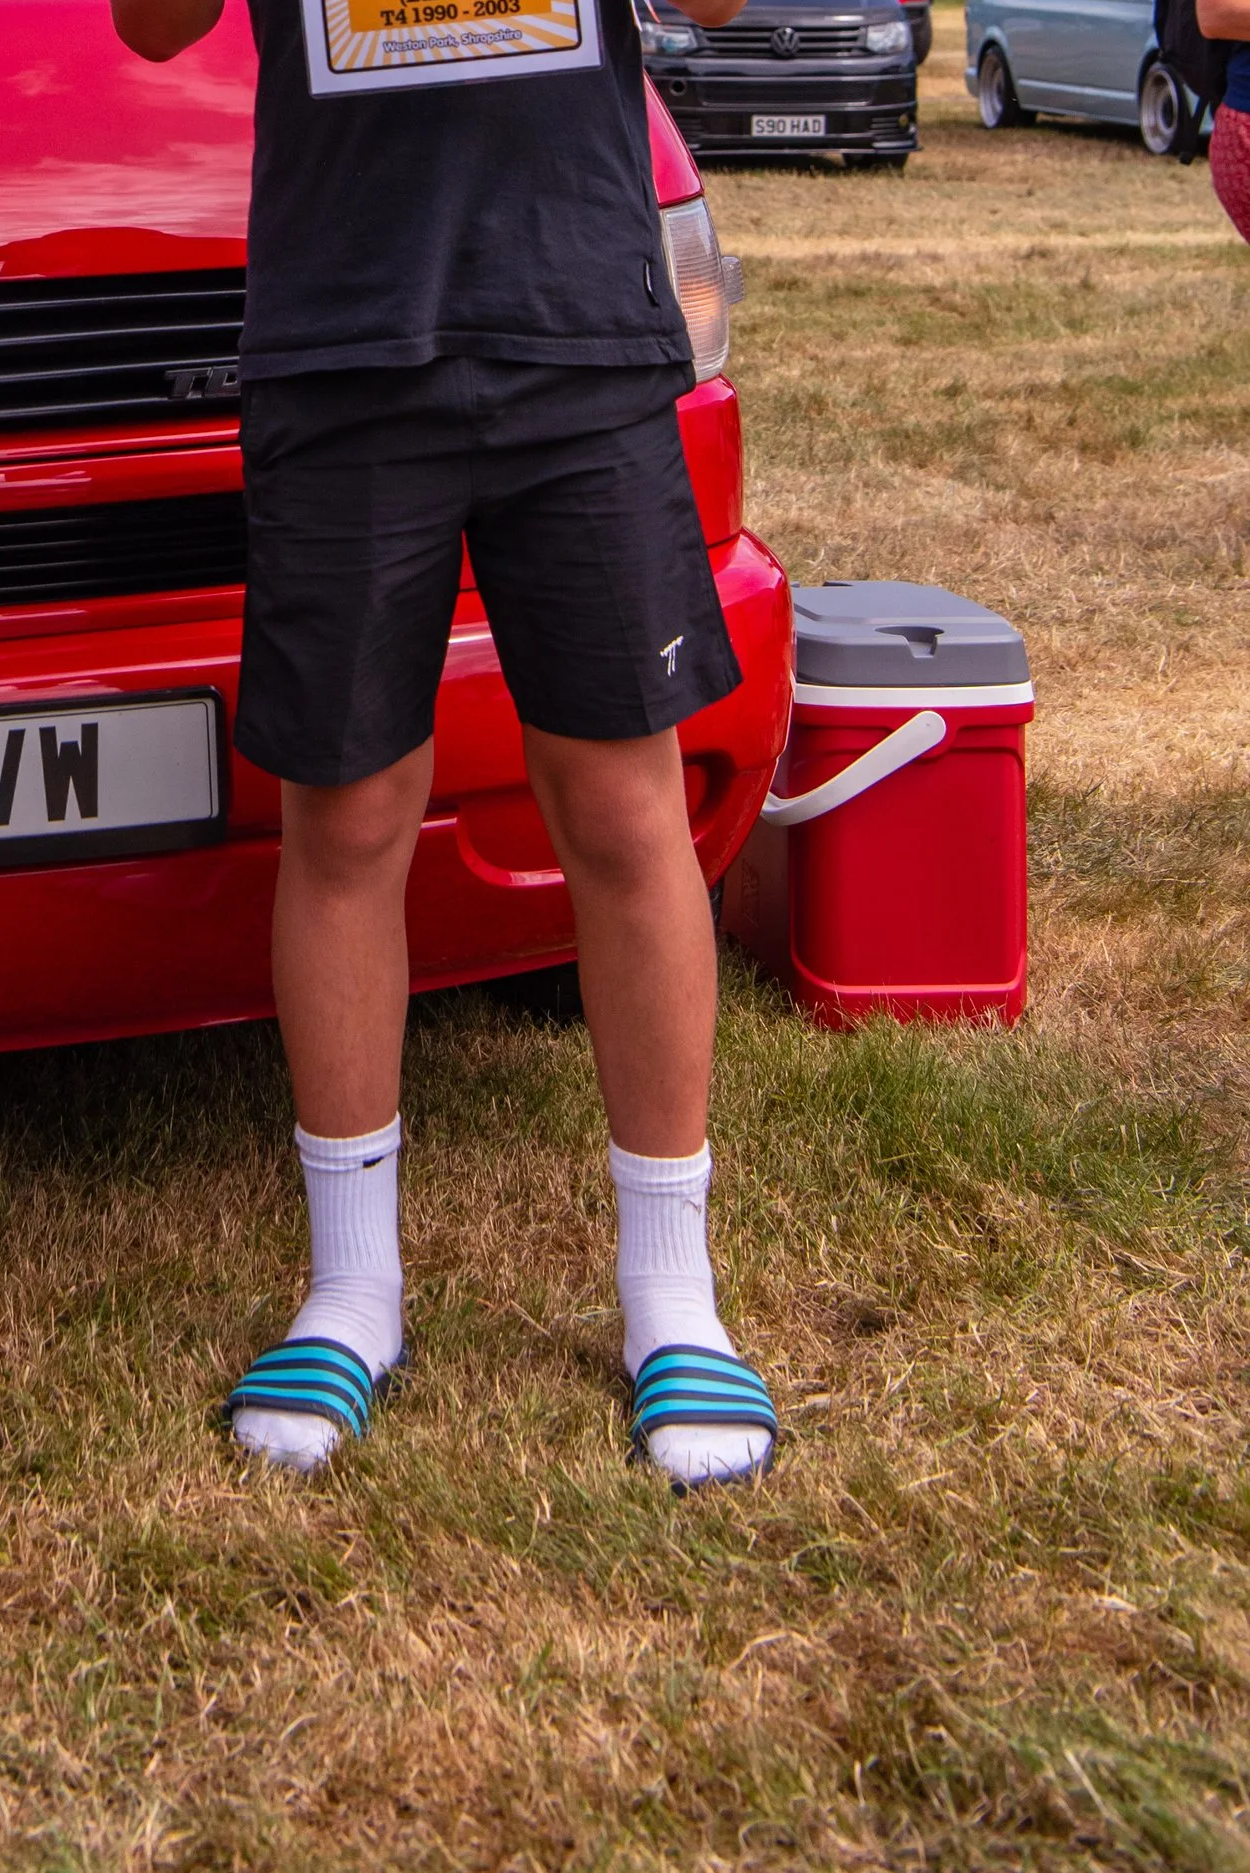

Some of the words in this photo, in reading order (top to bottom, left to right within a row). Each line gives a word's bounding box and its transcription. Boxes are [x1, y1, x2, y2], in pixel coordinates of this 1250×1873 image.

[380, 10, 407, 26] T4
[412, 4, 458, 23] 1990
[382, 39, 428, 53] Weston
[460, 29, 523, 46] Shropshire
[755, 119, 786, 134] S90
